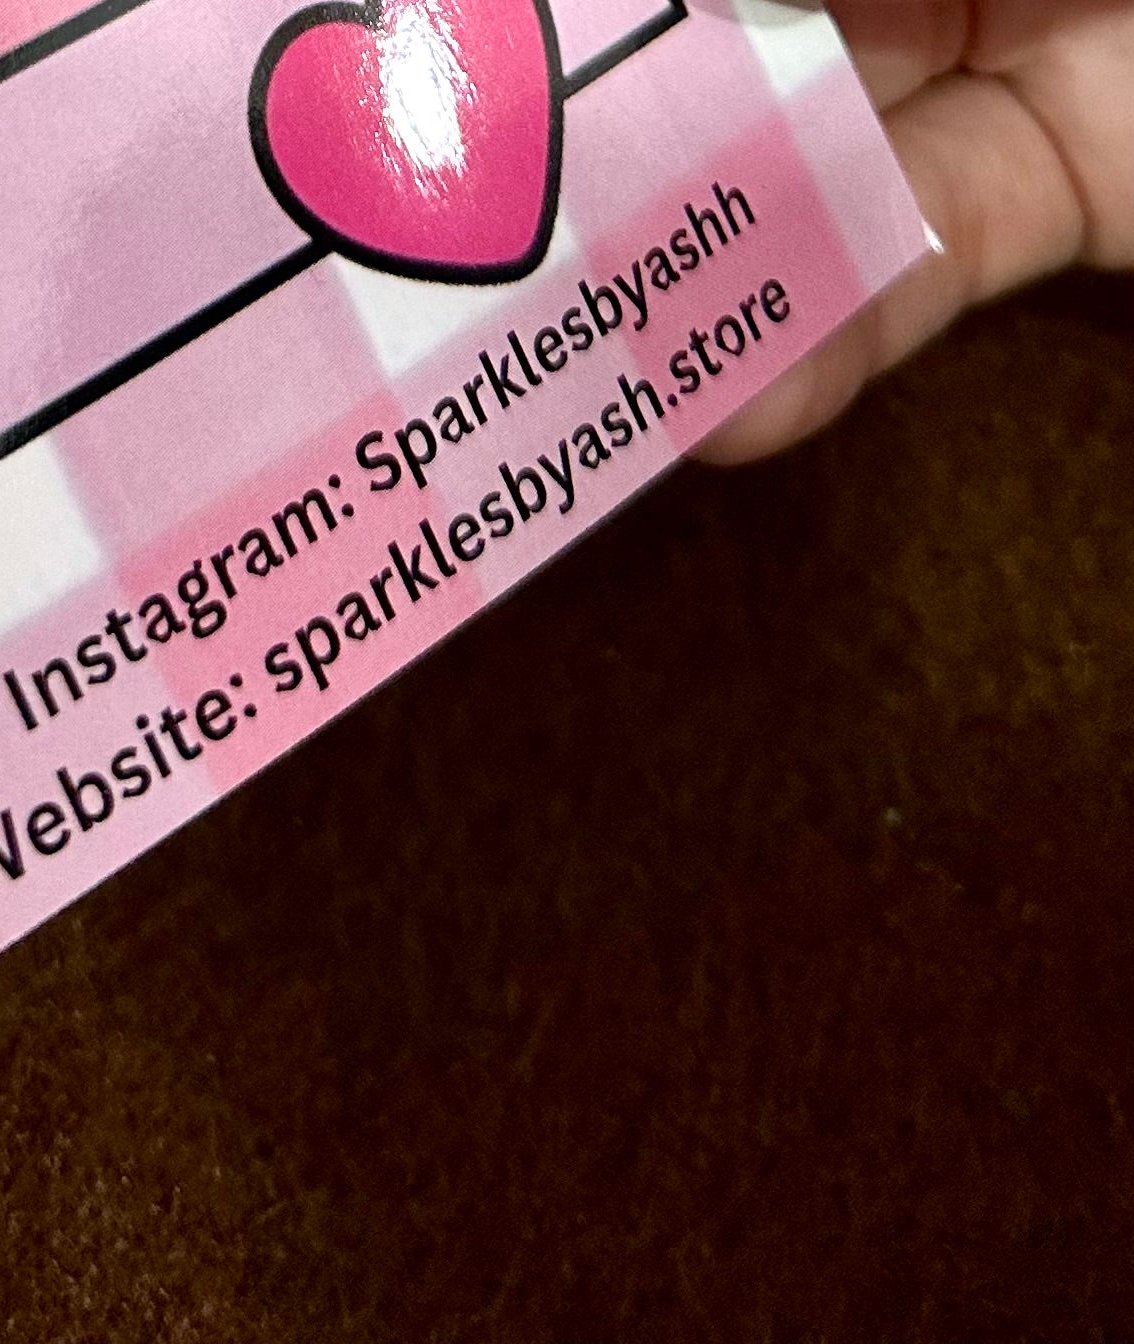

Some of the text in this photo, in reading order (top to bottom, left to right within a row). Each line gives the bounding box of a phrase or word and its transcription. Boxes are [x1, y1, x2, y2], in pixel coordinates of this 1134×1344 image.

[4, 181, 757, 731] Instagram: Sparklesbyashh
[265, 277, 792, 693] sparklesbyash.store
